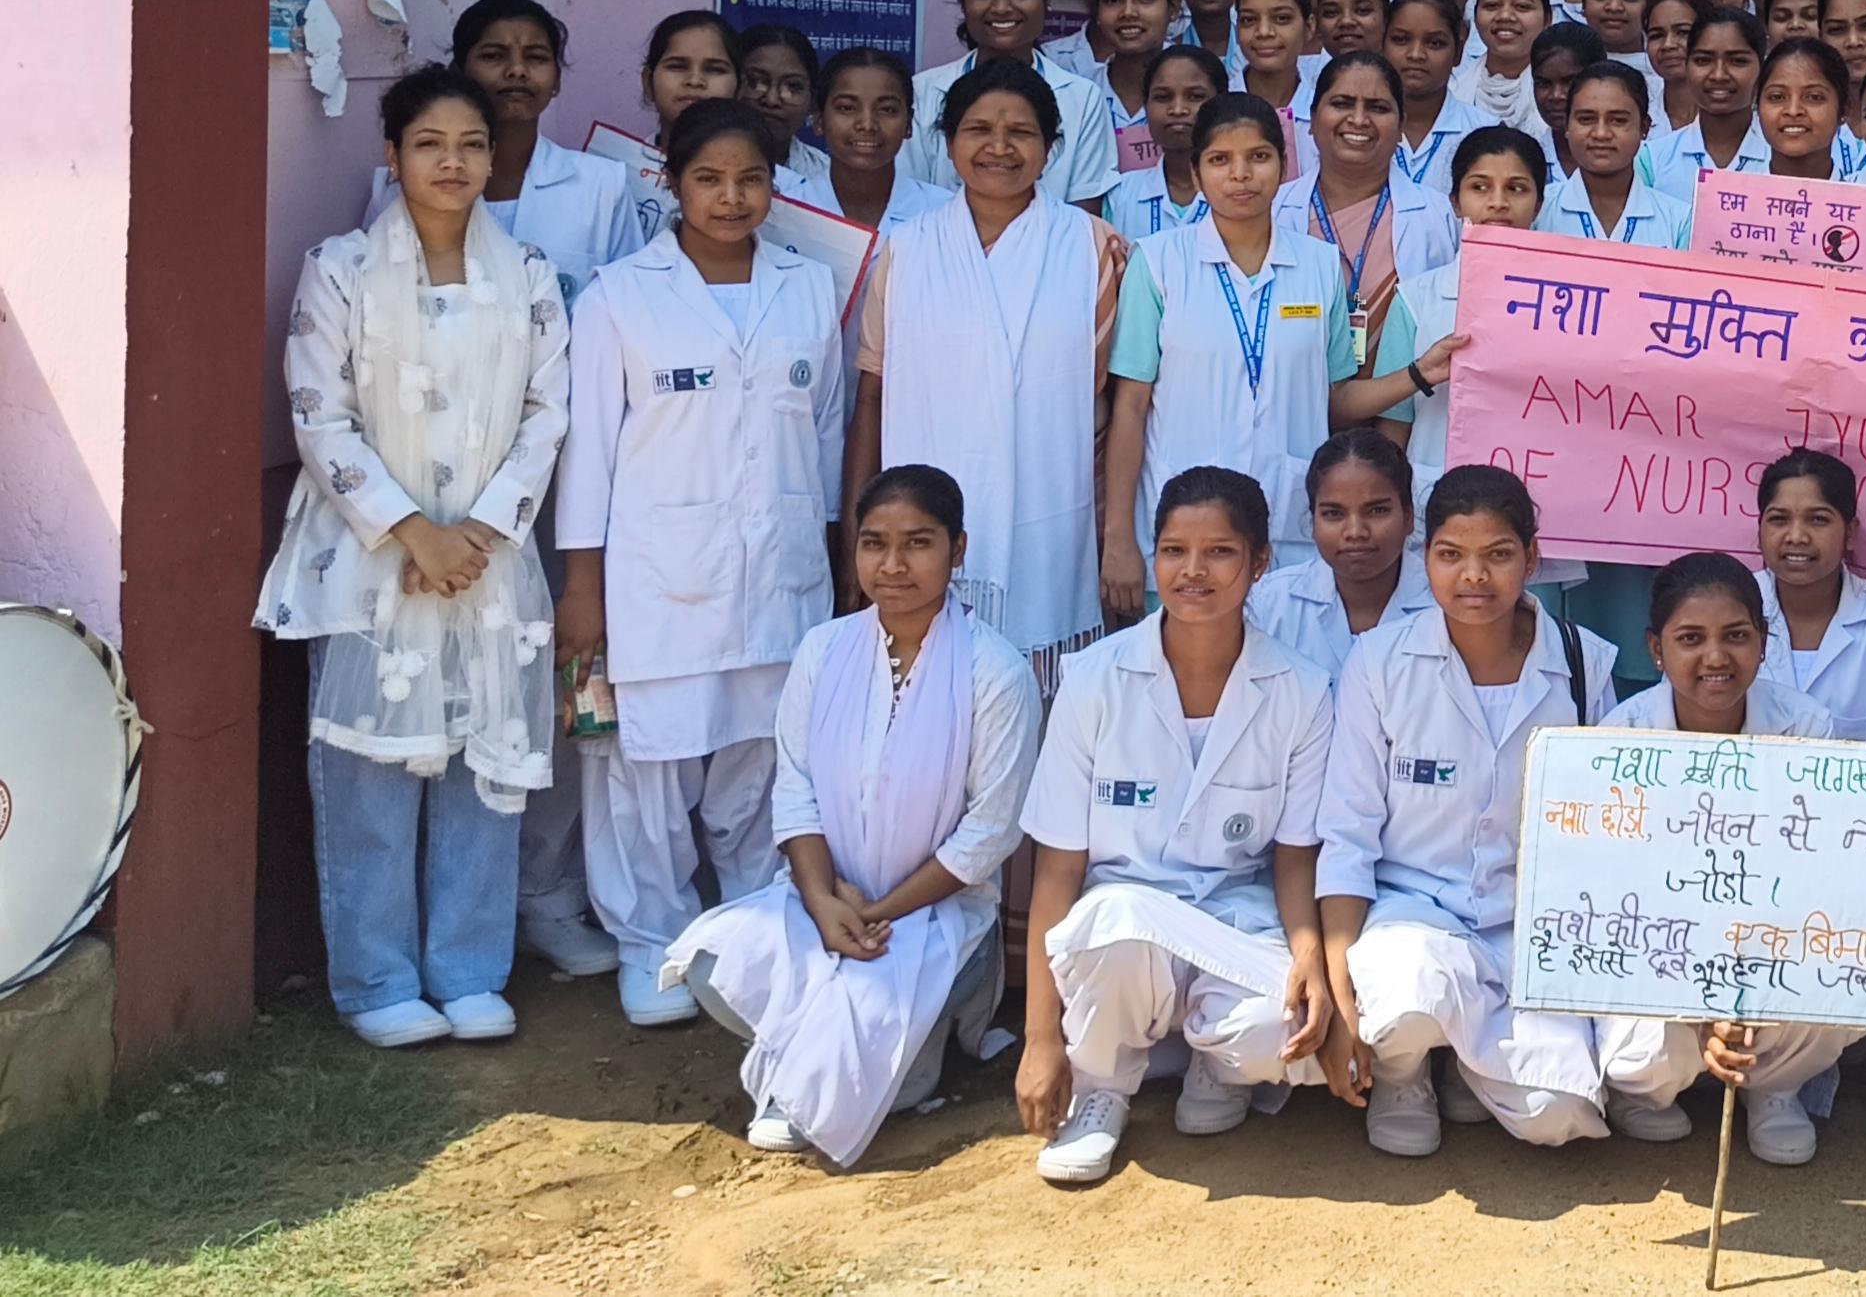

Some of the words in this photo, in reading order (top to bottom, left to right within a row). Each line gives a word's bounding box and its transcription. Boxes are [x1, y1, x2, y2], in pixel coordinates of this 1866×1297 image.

[1718, 191, 1748, 212] हम
[1766, 188, 1813, 219] सबने
[1826, 202, 1862, 223] यह
[1730, 222, 1776, 243] ठाना
[1504, 274, 1610, 336] नशा
[1639, 288, 1799, 362] मुक्ति
[1521, 375, 1705, 441] AMAR
[1592, 745, 1672, 787] नशा
[1545, 800, 1591, 836] नशा
[1666, 791, 1770, 847] जीवन
[1778, 794, 1822, 853] से
[1604, 892, 1652, 950] की
[1642, 916, 1700, 956] लत
[1724, 922, 1798, 960] एक
